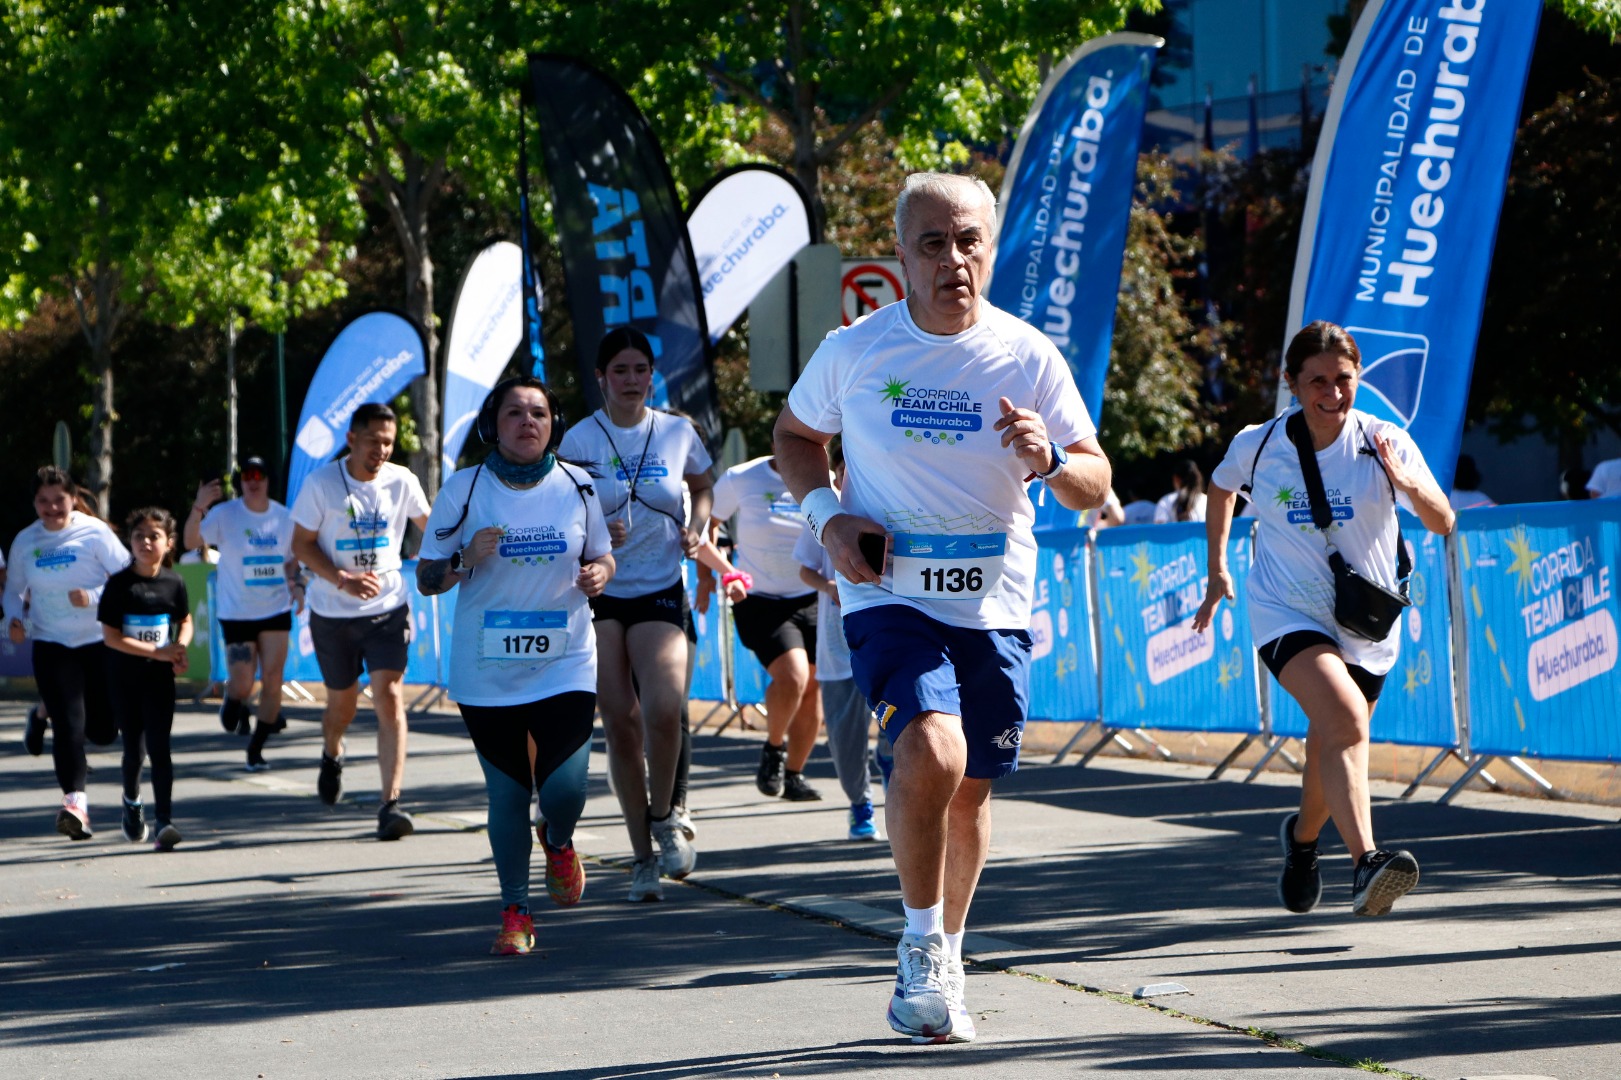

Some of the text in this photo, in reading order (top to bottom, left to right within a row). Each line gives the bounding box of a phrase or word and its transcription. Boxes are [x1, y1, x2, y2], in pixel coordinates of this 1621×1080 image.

[1355, 15, 1429, 302] MUNICIPALIDAD DE
[1018, 131, 1066, 327] NICIPALIDAD DE
[702, 203, 790, 299] uechuraba.
[906, 387, 971, 401] CORRIDA
[892, 397, 983, 413] TEAM CHILE
[899, 413, 974, 428] Huechuraba.
[1284, 499, 1312, 509] TEA
[499, 531, 566, 544] TEAM CHILE
[507, 525, 556, 535] CORRIDA
[353, 552, 377, 567] 152
[1531, 535, 1595, 596] CORRIDA
[920, 566, 983, 593] 1136
[1147, 551, 1197, 601] CORRIDA
[1521, 565, 1611, 639] TEAM CHILE
[138, 630, 161, 643] 168
[502, 635, 550, 654] 1179
[1536, 632, 1608, 685] Huechuraba.
